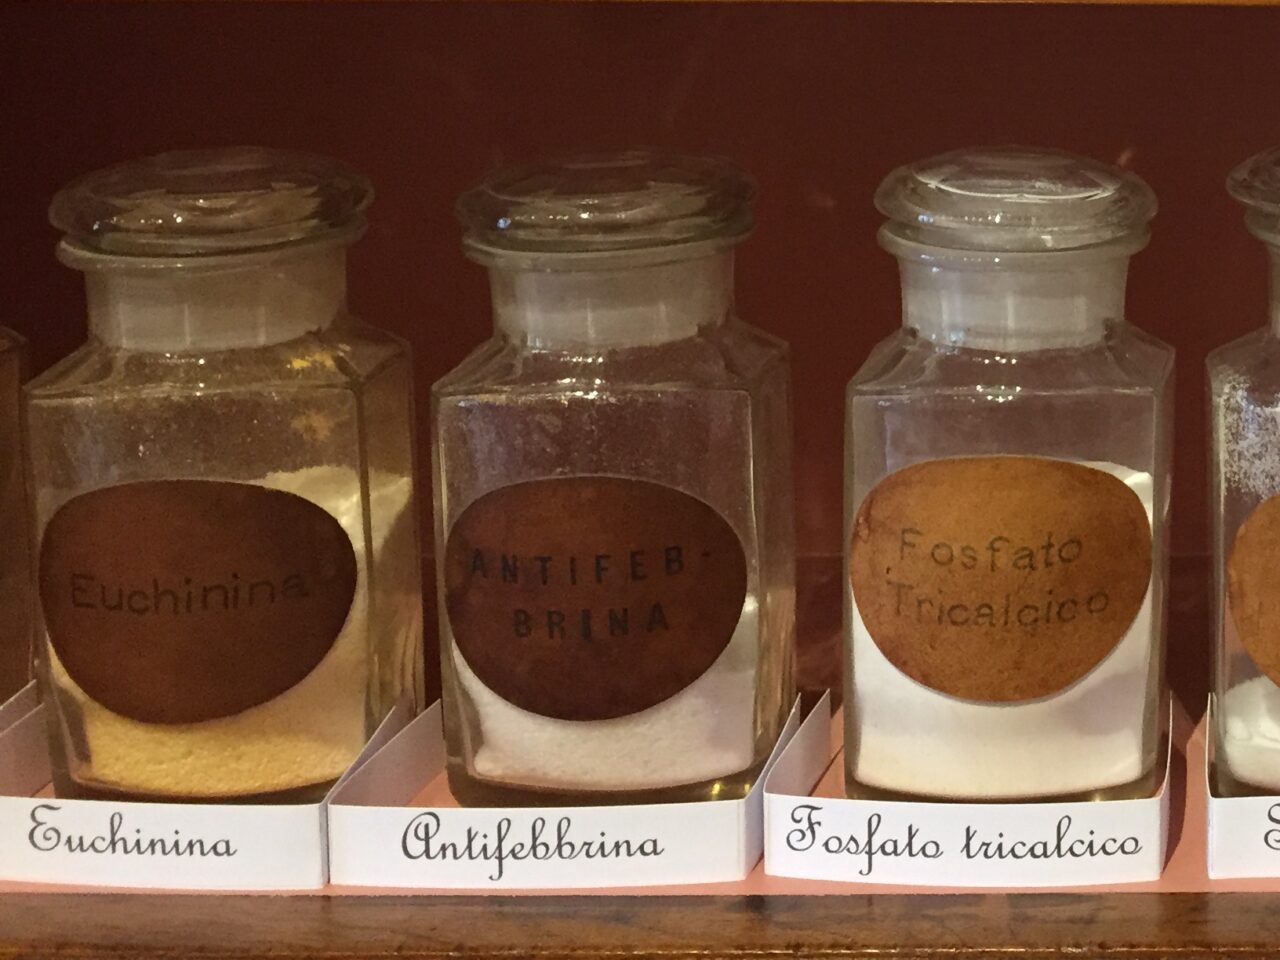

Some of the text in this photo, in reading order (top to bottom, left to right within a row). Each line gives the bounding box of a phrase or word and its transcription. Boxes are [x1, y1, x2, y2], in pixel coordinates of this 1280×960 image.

[900, 527, 1083, 572] Fosfato
[71, 571, 311, 616] Euchinina
[885, 579, 1109, 628] Tricalcico
[512, 601, 670, 641] BRINA
[27, 804, 238, 858] Euchinina
[401, 809, 665, 882] Antifebbrina
[785, 803, 1144, 876] Fosfato tricalcico
